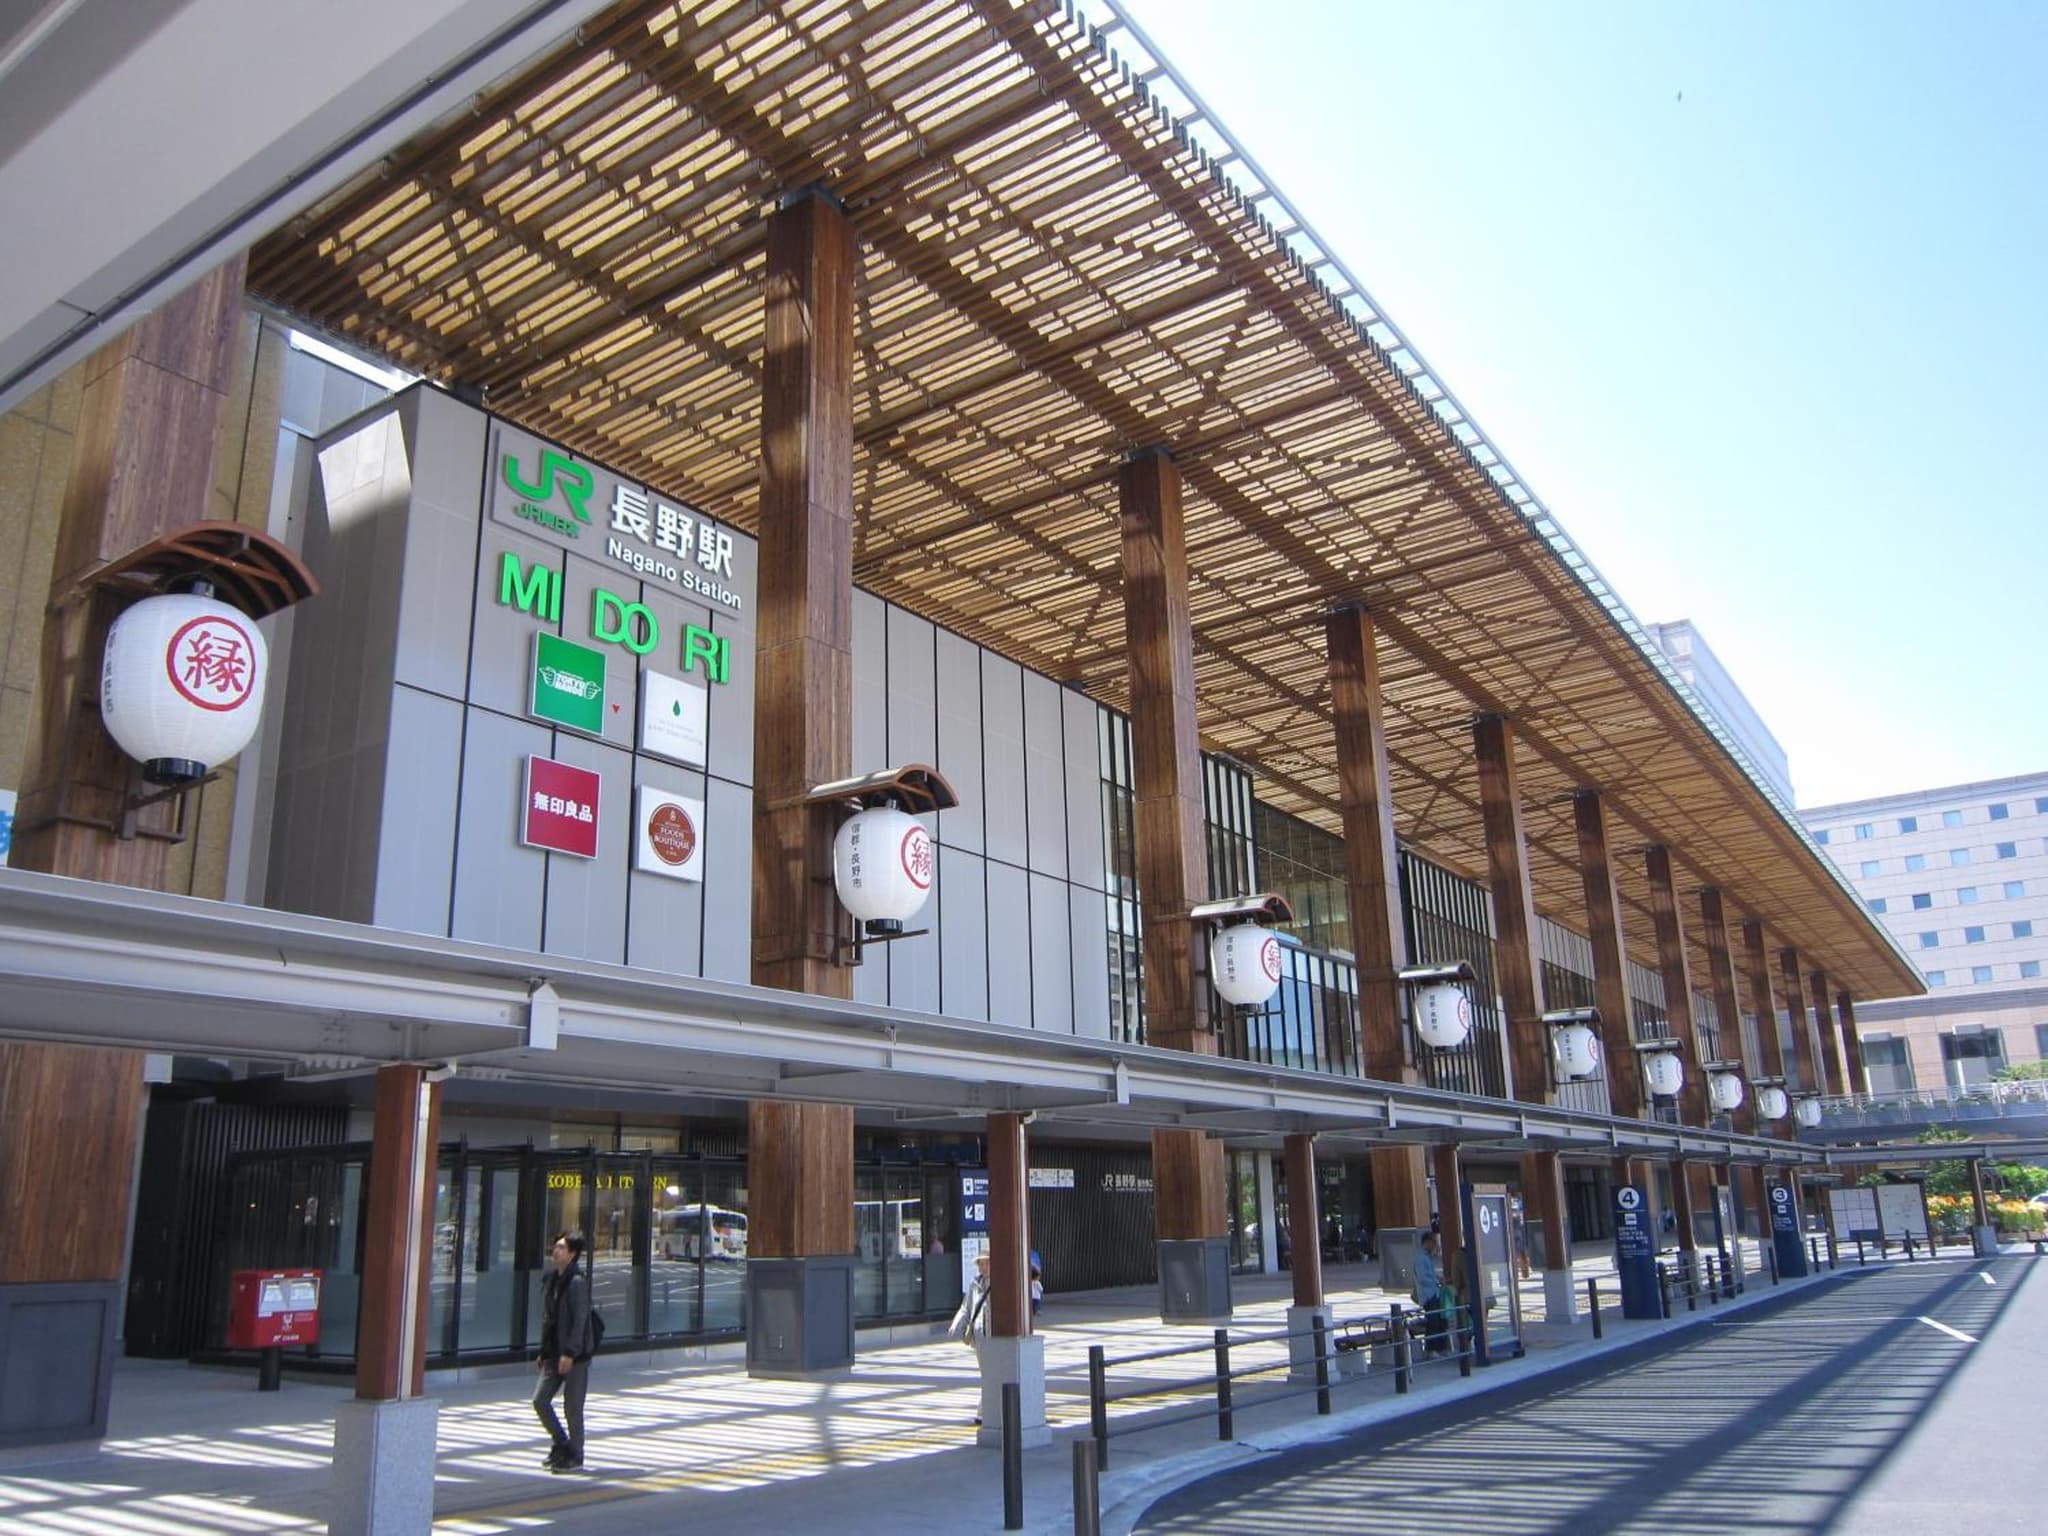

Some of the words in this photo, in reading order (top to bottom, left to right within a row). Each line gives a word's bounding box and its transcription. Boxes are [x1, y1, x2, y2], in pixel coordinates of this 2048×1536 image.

[503, 448, 596, 524] JR
[611, 484, 733, 579] 長野駅
[608, 537, 677, 582] Nagano
[682, 570, 741, 609] Station
[184, 630, 247, 693] 縁
[533, 791, 593, 823] 無印良品
[1622, 1191, 1636, 1205] 4
[1775, 1190, 1785, 1200] 3
